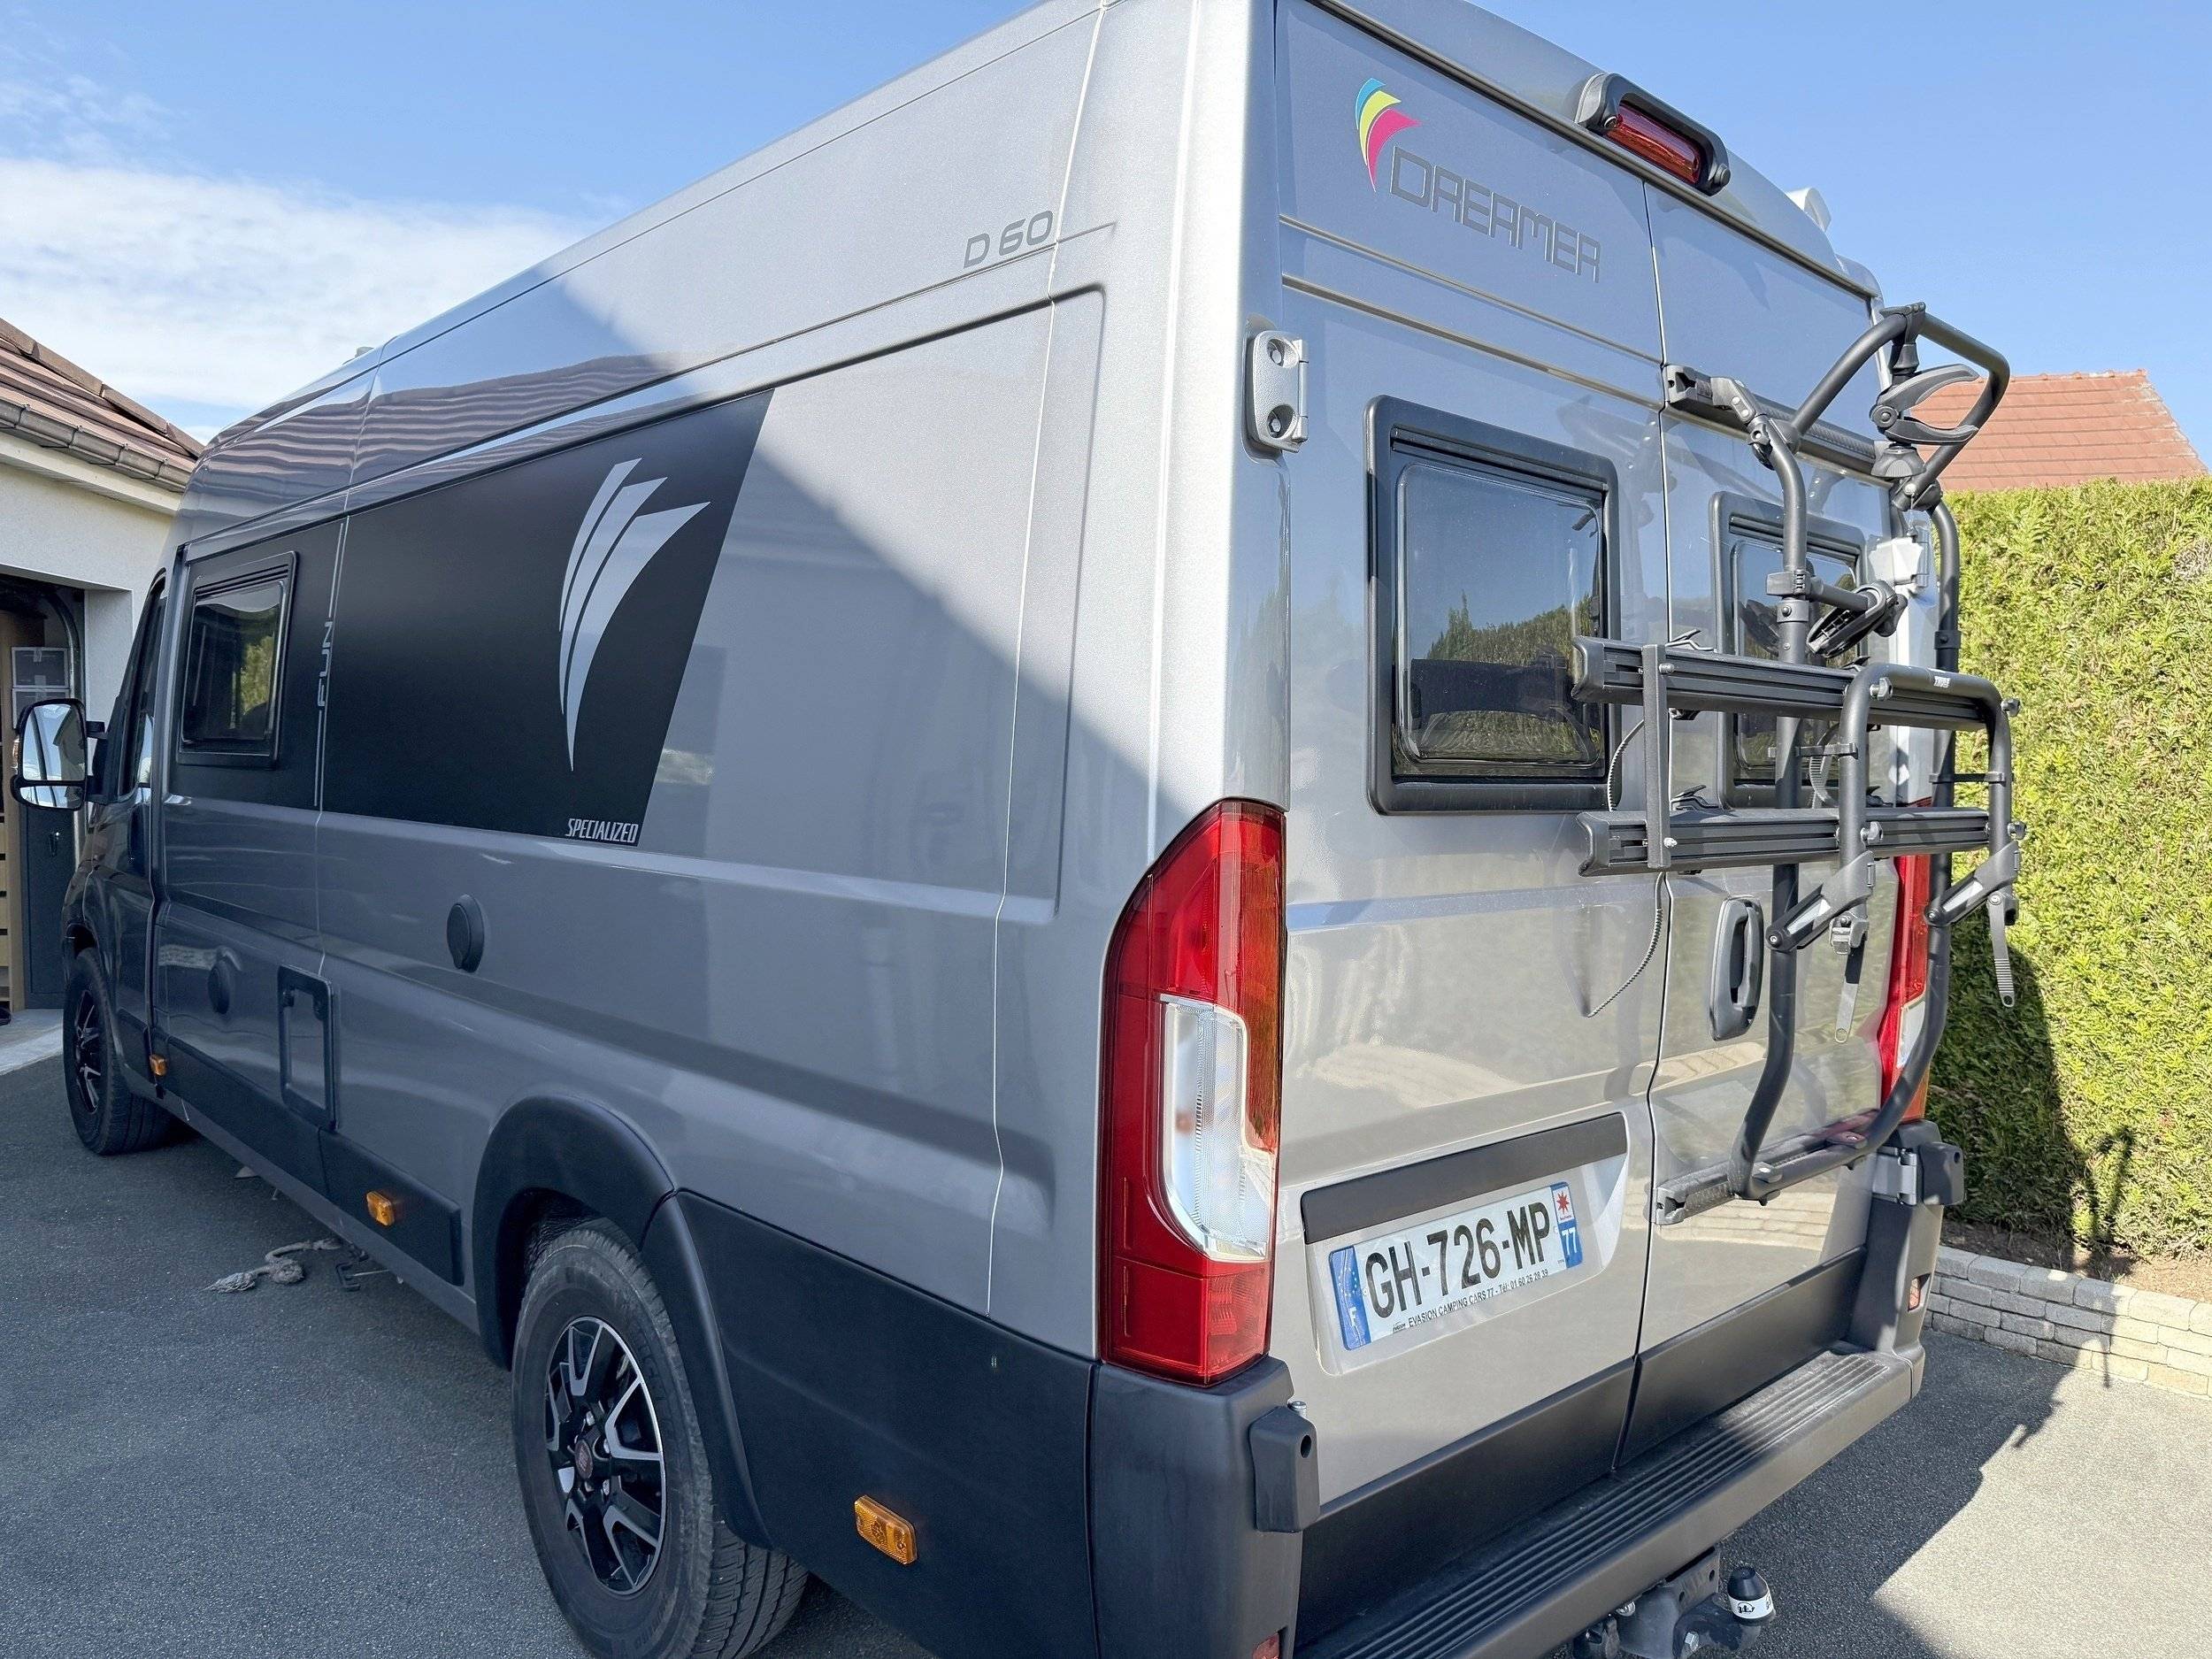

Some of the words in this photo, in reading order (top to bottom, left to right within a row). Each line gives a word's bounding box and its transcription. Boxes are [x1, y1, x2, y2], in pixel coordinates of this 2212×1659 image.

[963, 233, 991, 269] D
[998, 210, 1054, 257] 60
[1390, 145, 1601, 284] DREAMER
[318, 621, 334, 707] FUN
[565, 818, 639, 843] SPECIALIZED
[1364, 1202, 1550, 1318] GH-726-MP
[1561, 1226, 1578, 1256] 77
[1349, 1306, 1357, 1327] F
[1409, 1309, 1438, 1327] EVASION
[1439, 1297, 1468, 1317] CAMPING
[1469, 1290, 1486, 1304] CARS
[1487, 1287, 1494, 1298] 77
[1509, 1279, 1517, 1290] 01
[1518, 1276, 1525, 1287] 60
[1525, 1273, 1533, 1284] 26
[1541, 1268, 1548, 1279] 39
